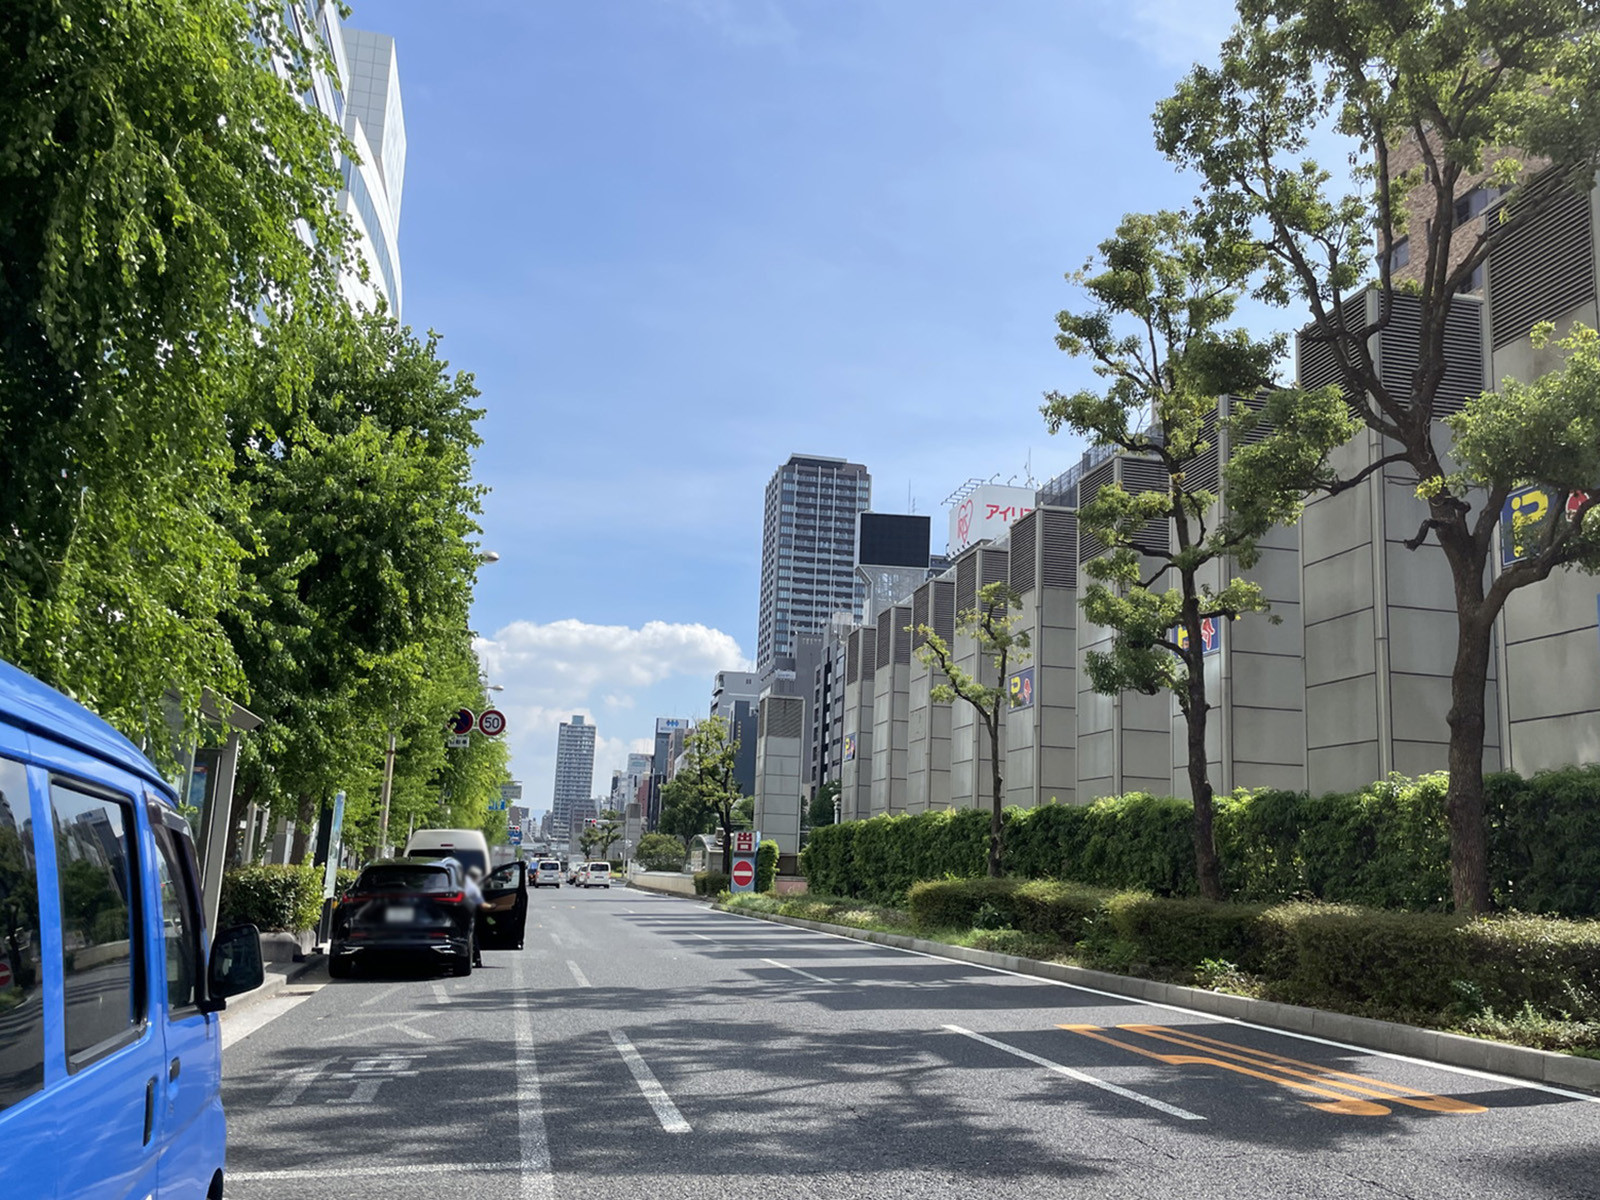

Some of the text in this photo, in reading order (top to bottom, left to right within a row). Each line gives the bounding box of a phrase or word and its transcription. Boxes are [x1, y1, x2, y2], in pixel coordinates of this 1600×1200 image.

[484, 717, 500, 729] 50
[737, 832, 752, 851] 出
[1054, 1024, 1488, 1115] 50
